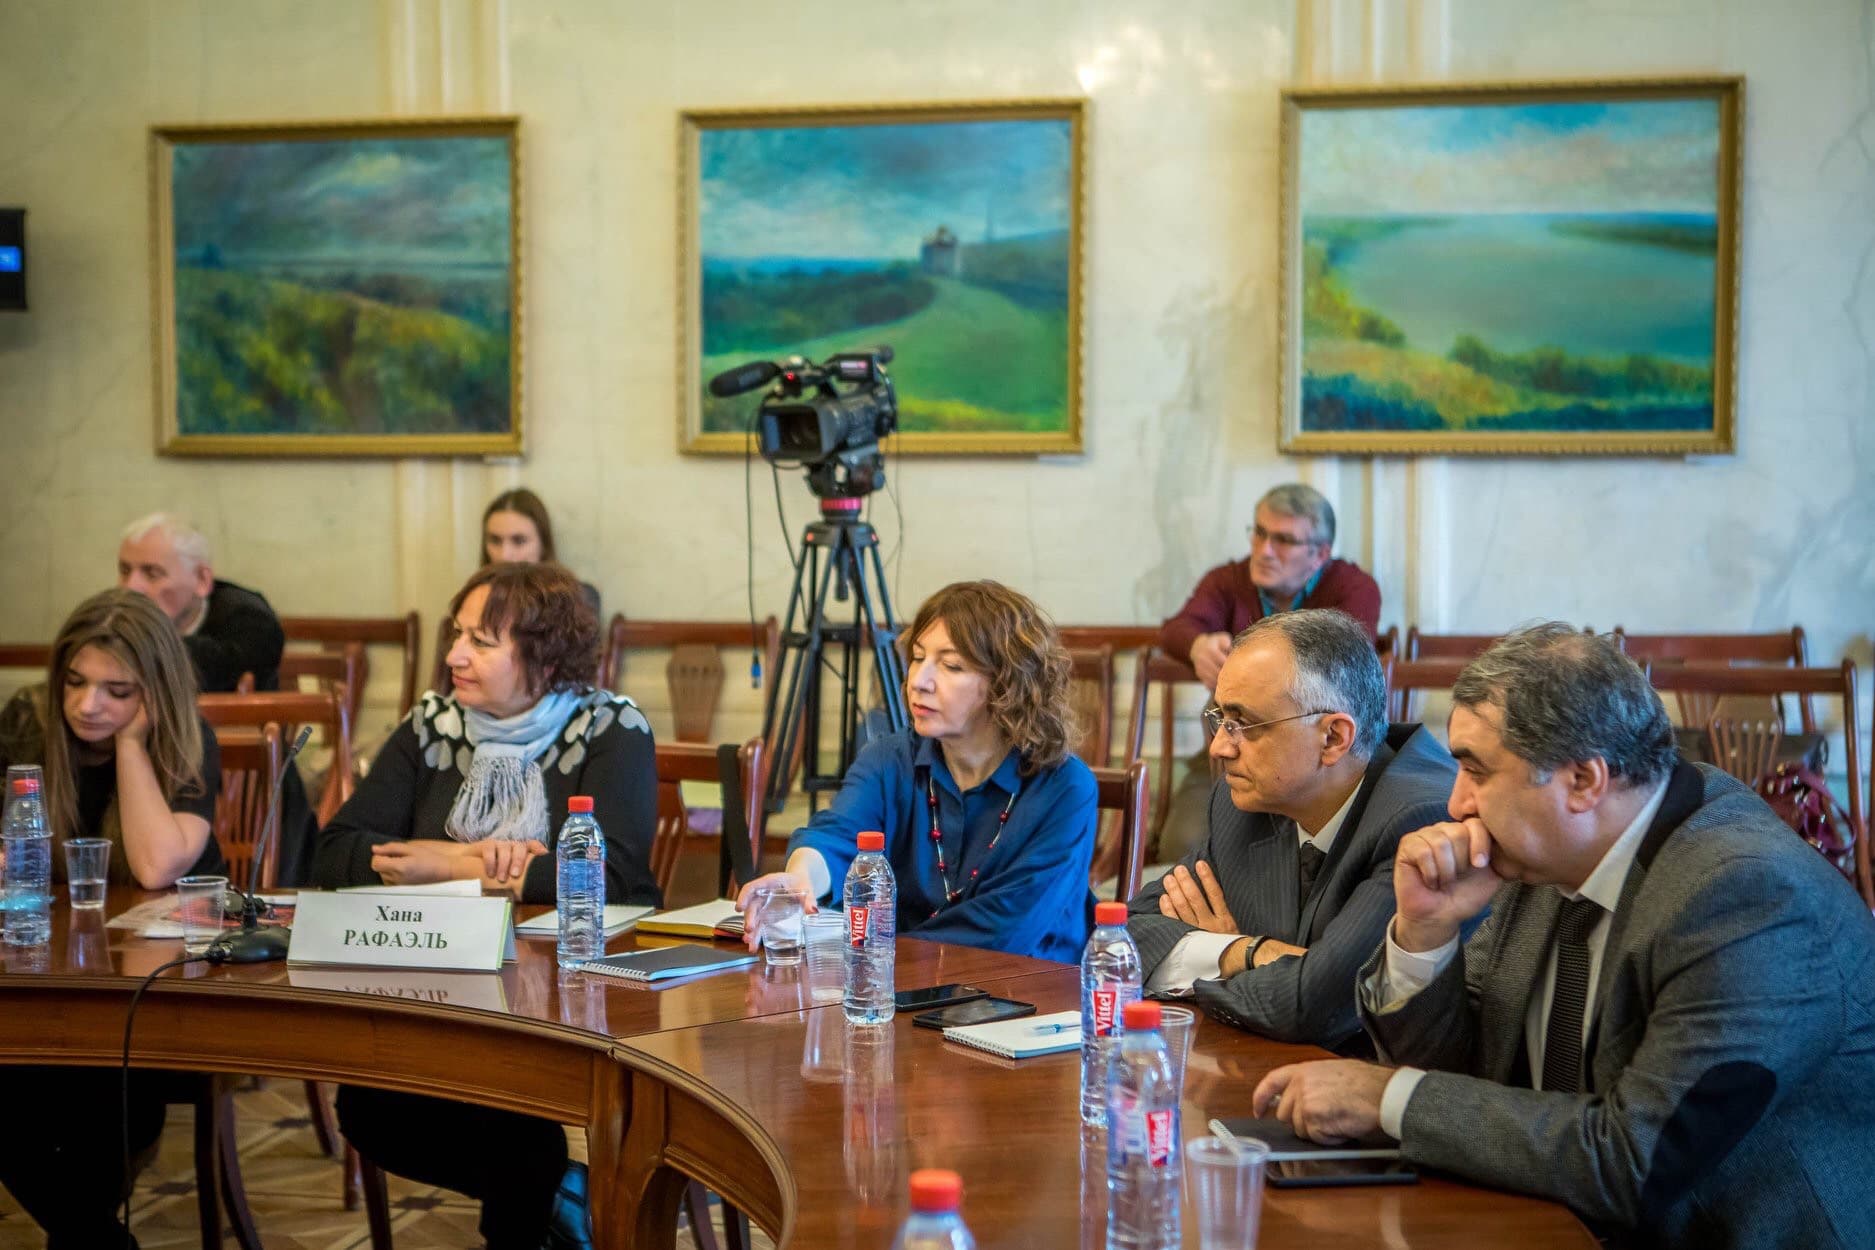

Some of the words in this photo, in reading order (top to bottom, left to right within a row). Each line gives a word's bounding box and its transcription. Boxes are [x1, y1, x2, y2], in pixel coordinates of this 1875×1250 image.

[376, 905, 423, 922] Хана
[852, 909, 865, 942] Vittel
[344, 929, 448, 949] РАФАЭЛЬ
[1096, 993, 1112, 1031] Vittel
